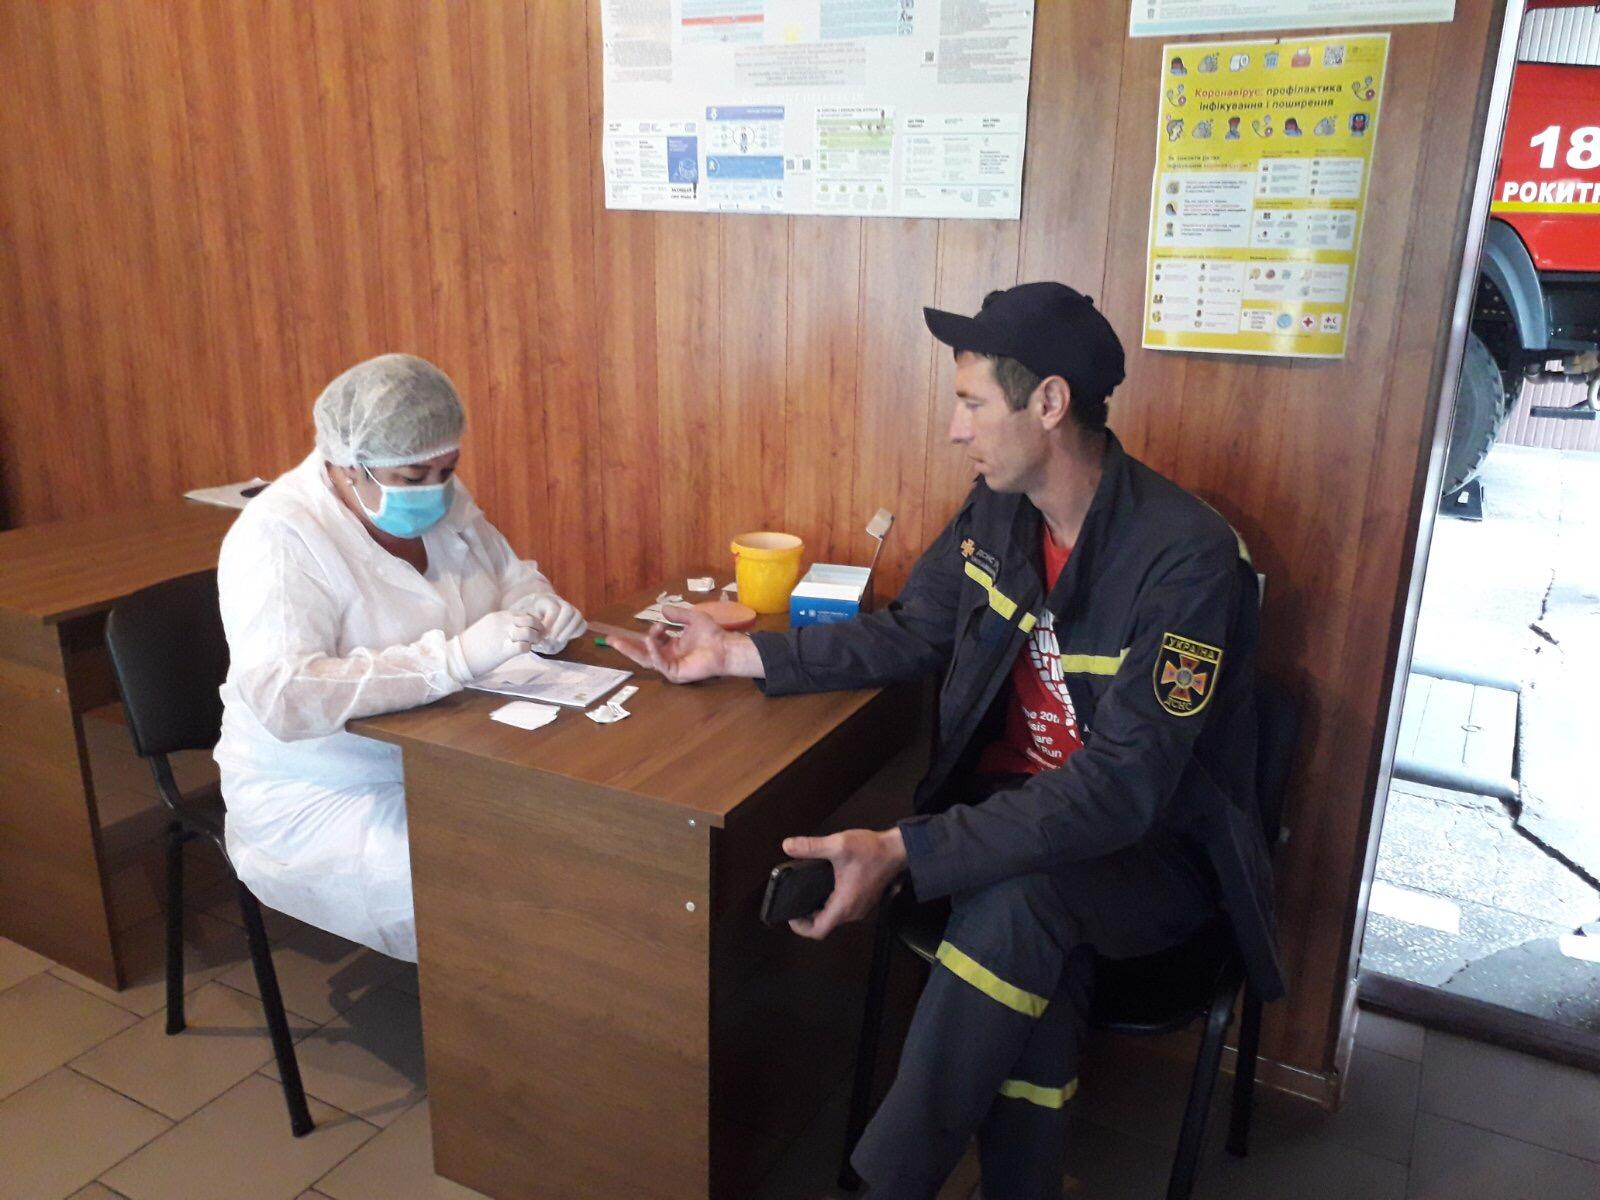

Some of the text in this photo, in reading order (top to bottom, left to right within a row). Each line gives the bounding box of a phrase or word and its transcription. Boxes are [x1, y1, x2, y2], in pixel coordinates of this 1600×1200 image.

[1266, 84, 1342, 96] профілактика
[1199, 101, 1263, 112] інфікування
[1272, 98, 1334, 109] поширення
[1530, 124, 1600, 170] 18
[1169, 637, 1215, 660] УКРАЇНА
